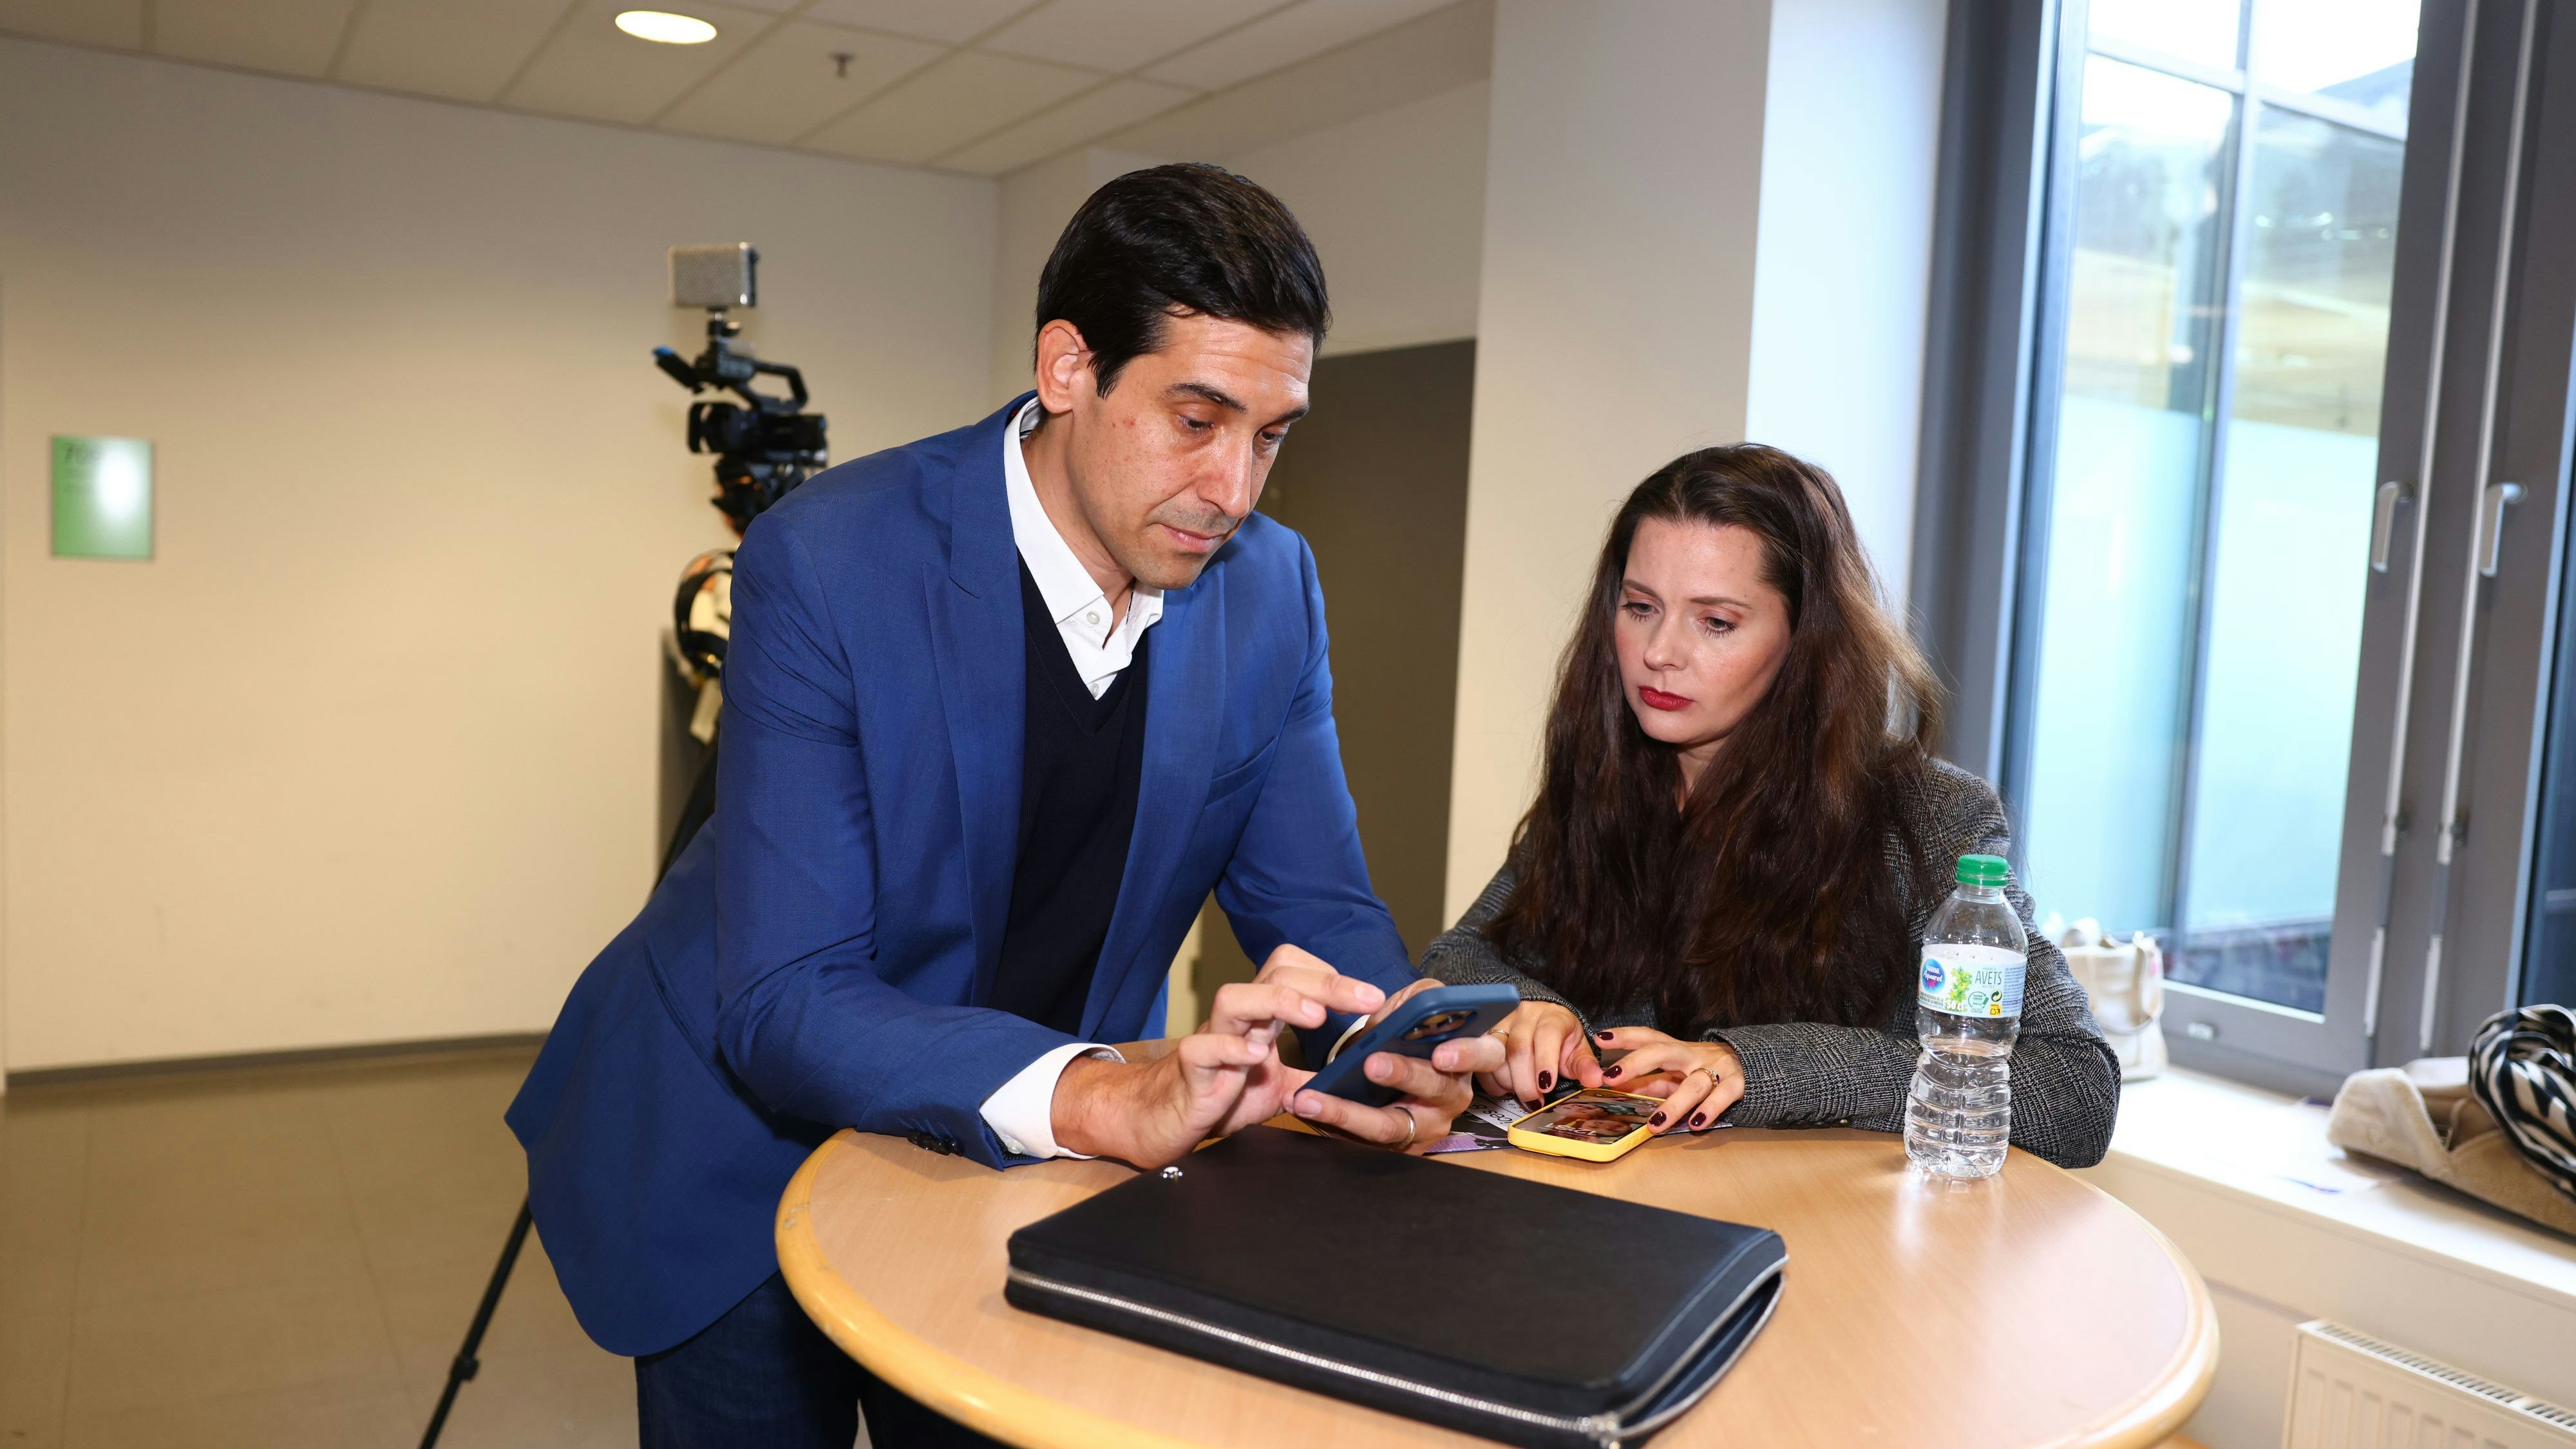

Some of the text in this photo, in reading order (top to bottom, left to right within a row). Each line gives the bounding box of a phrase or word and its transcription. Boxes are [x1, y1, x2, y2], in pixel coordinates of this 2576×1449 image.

[1923, 969, 1943, 982] Aquarel
[1975, 971, 2002, 985] AVETS
[1947, 999, 1956, 1010] 50
[1545, 1123, 1596, 1136] 12:31
